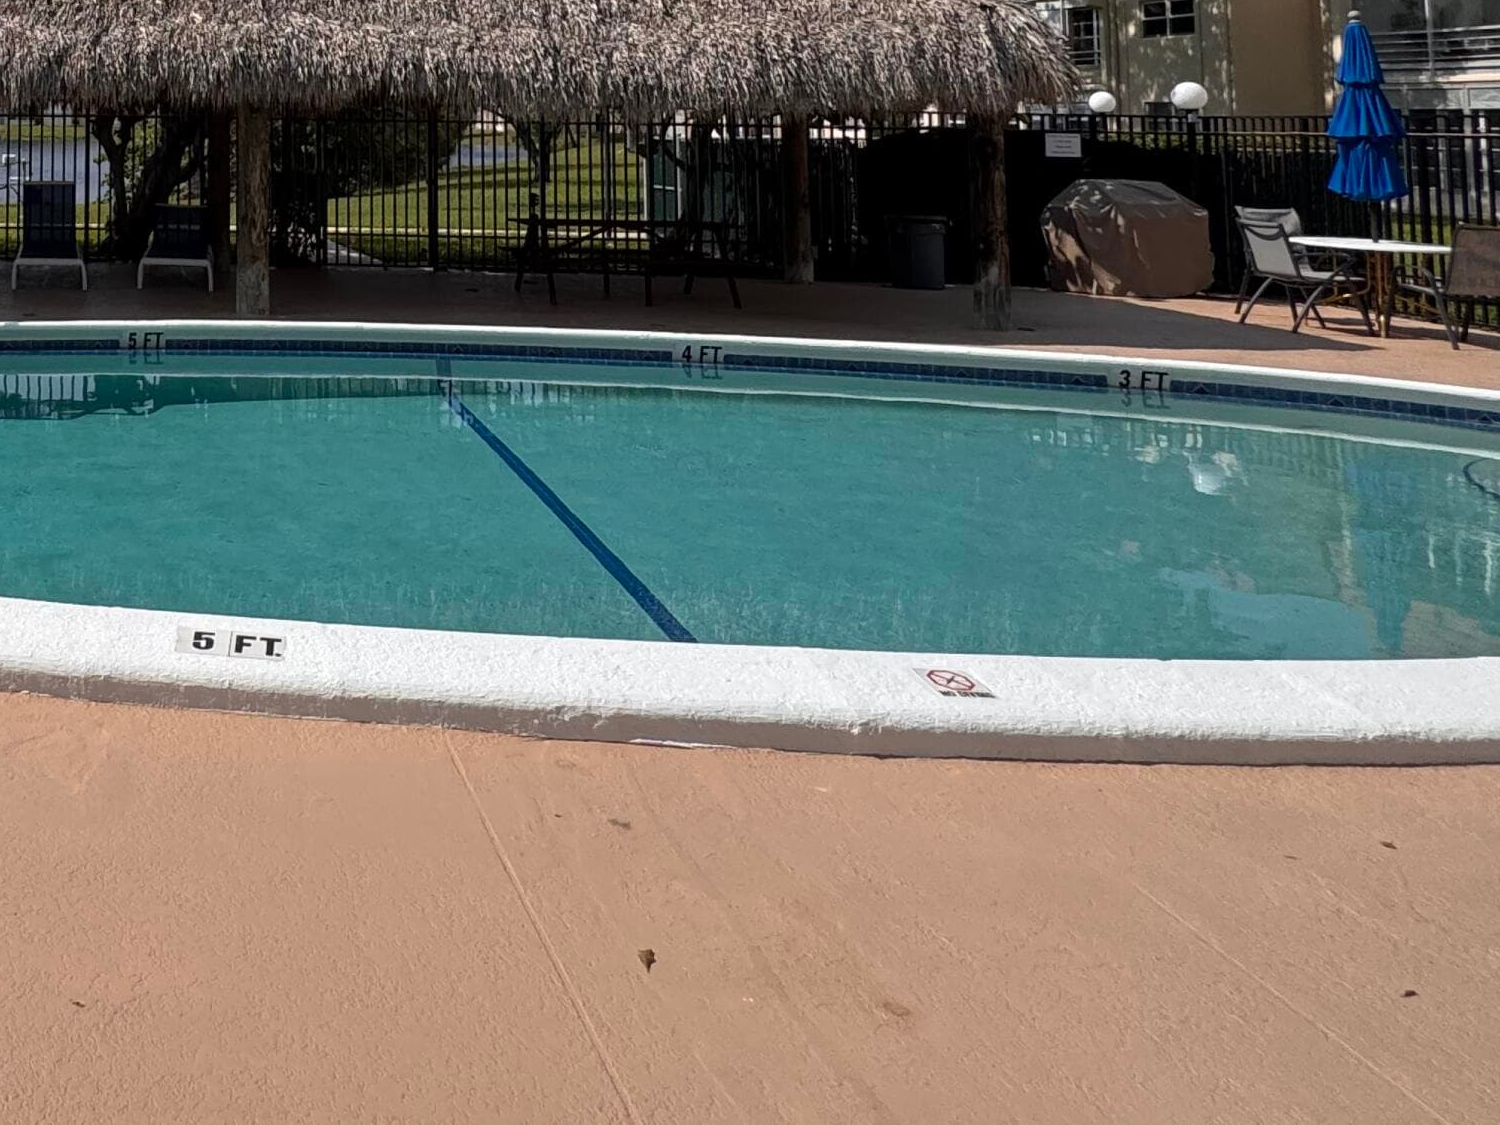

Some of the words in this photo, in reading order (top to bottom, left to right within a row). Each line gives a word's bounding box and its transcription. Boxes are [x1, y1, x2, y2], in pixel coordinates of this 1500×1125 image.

[128, 332, 137, 349] 5
[144, 332, 164, 349] FT
[682, 345, 692, 363] 4
[700, 346, 722, 363] FT
[1119, 370, 1131, 388] 3
[1141, 371, 1169, 390] FT
[192, 631, 215, 650] 5
[234, 635, 282, 657] FT.
